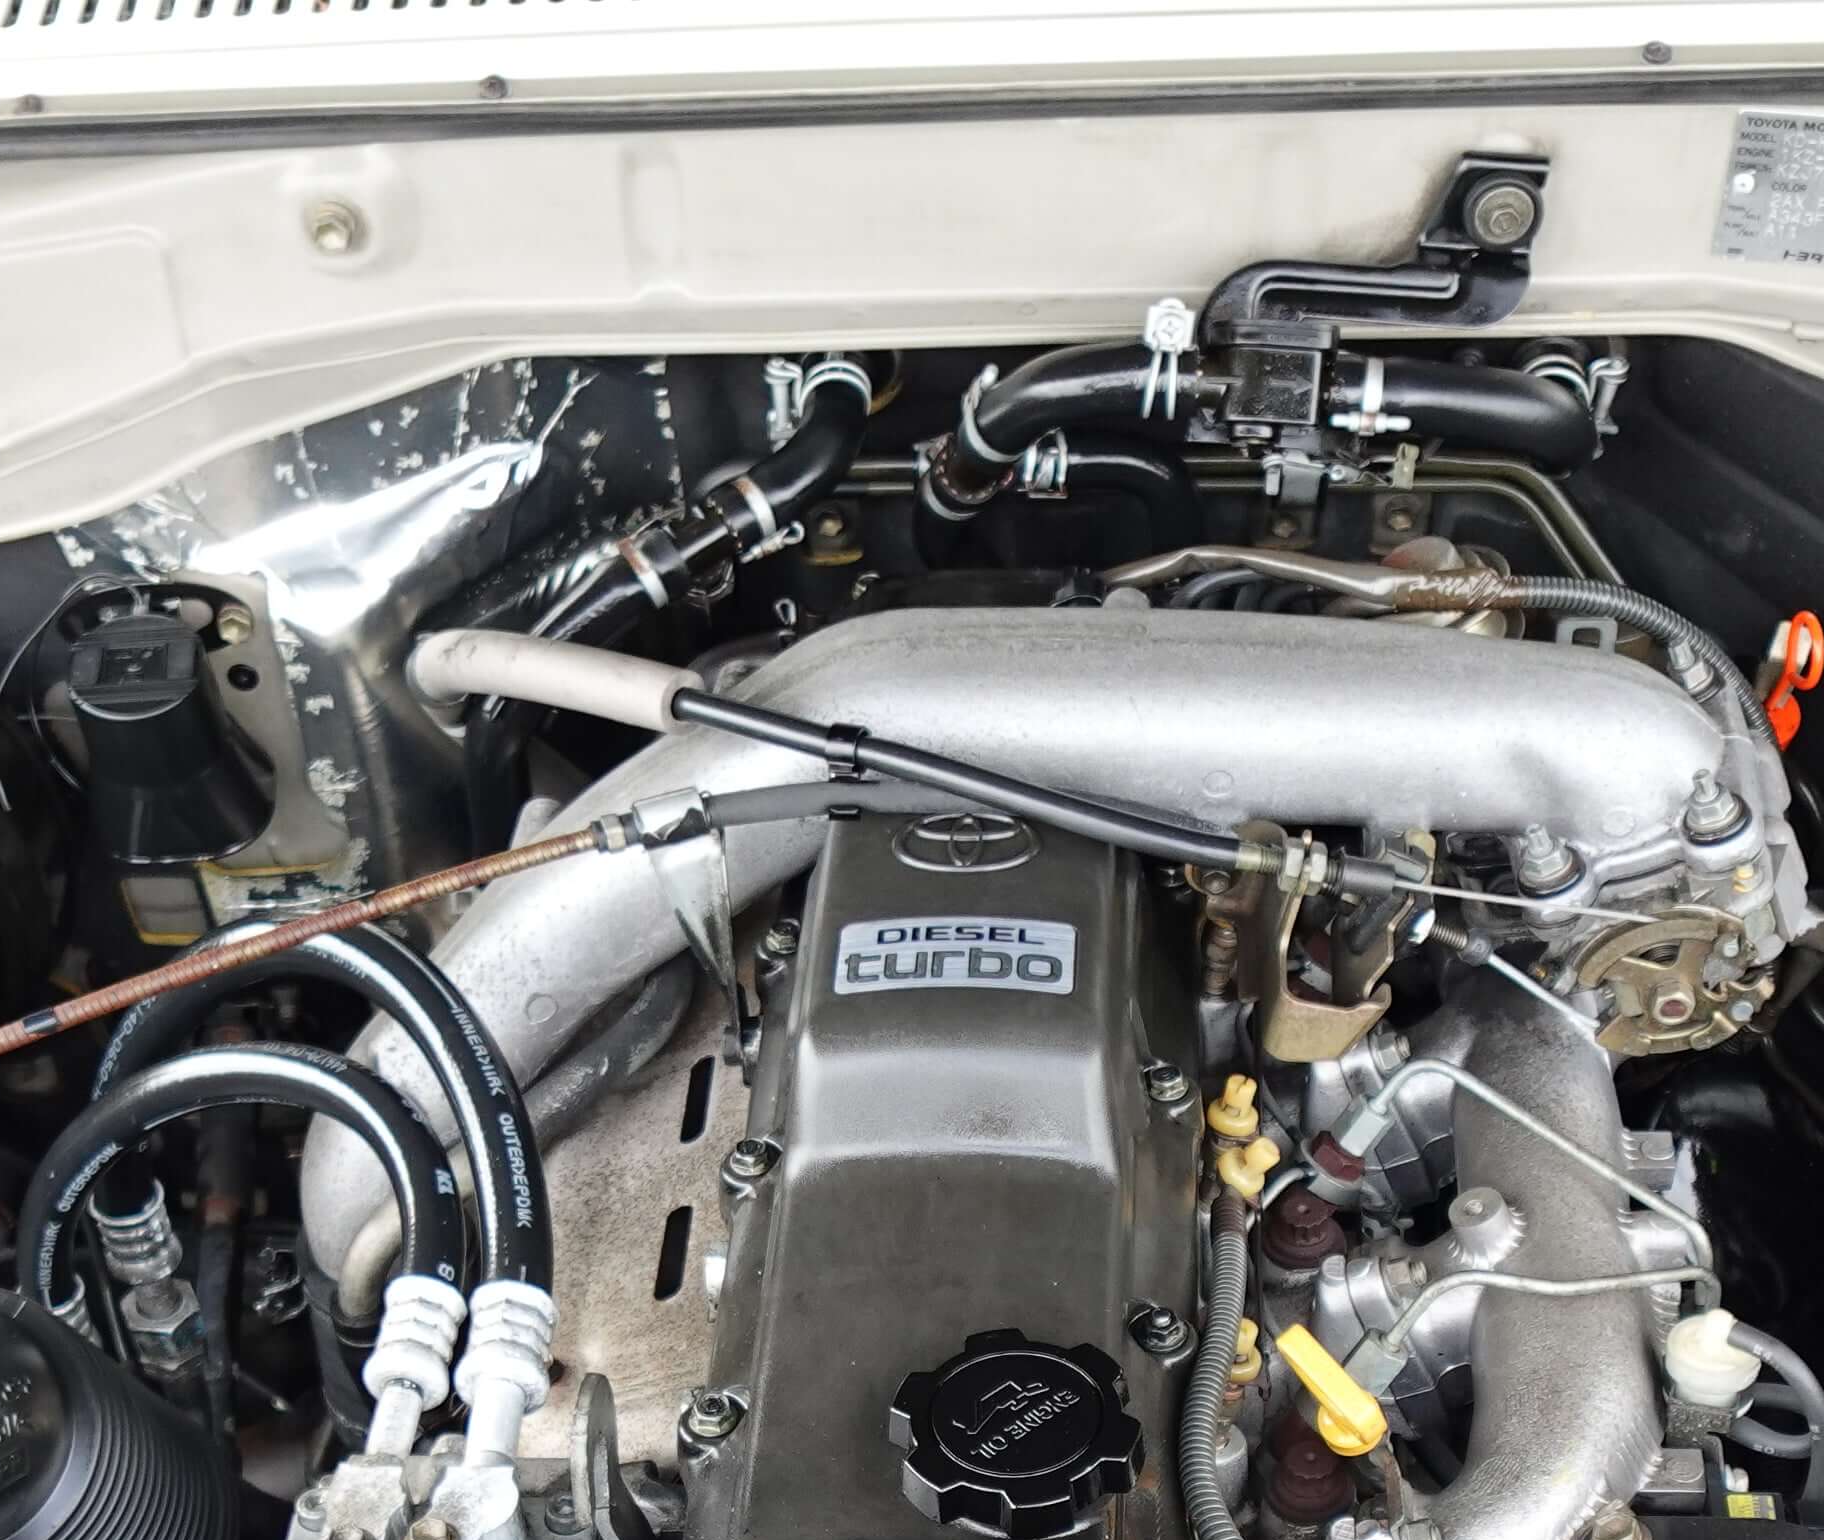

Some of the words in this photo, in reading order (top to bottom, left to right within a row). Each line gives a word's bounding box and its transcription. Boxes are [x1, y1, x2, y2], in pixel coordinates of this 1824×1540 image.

[1747, 117, 1798, 130] TOYOTA
[1740, 131, 1777, 143] MODEL
[1736, 147, 1775, 158] ENGINE
[1771, 182, 1808, 192] COLOR
[877, 926, 1045, 945] DIESEL
[845, 948, 1063, 984] turbo
[1004, 1391, 1081, 1440] ENGINE
[970, 1436, 1008, 1459] OIL
